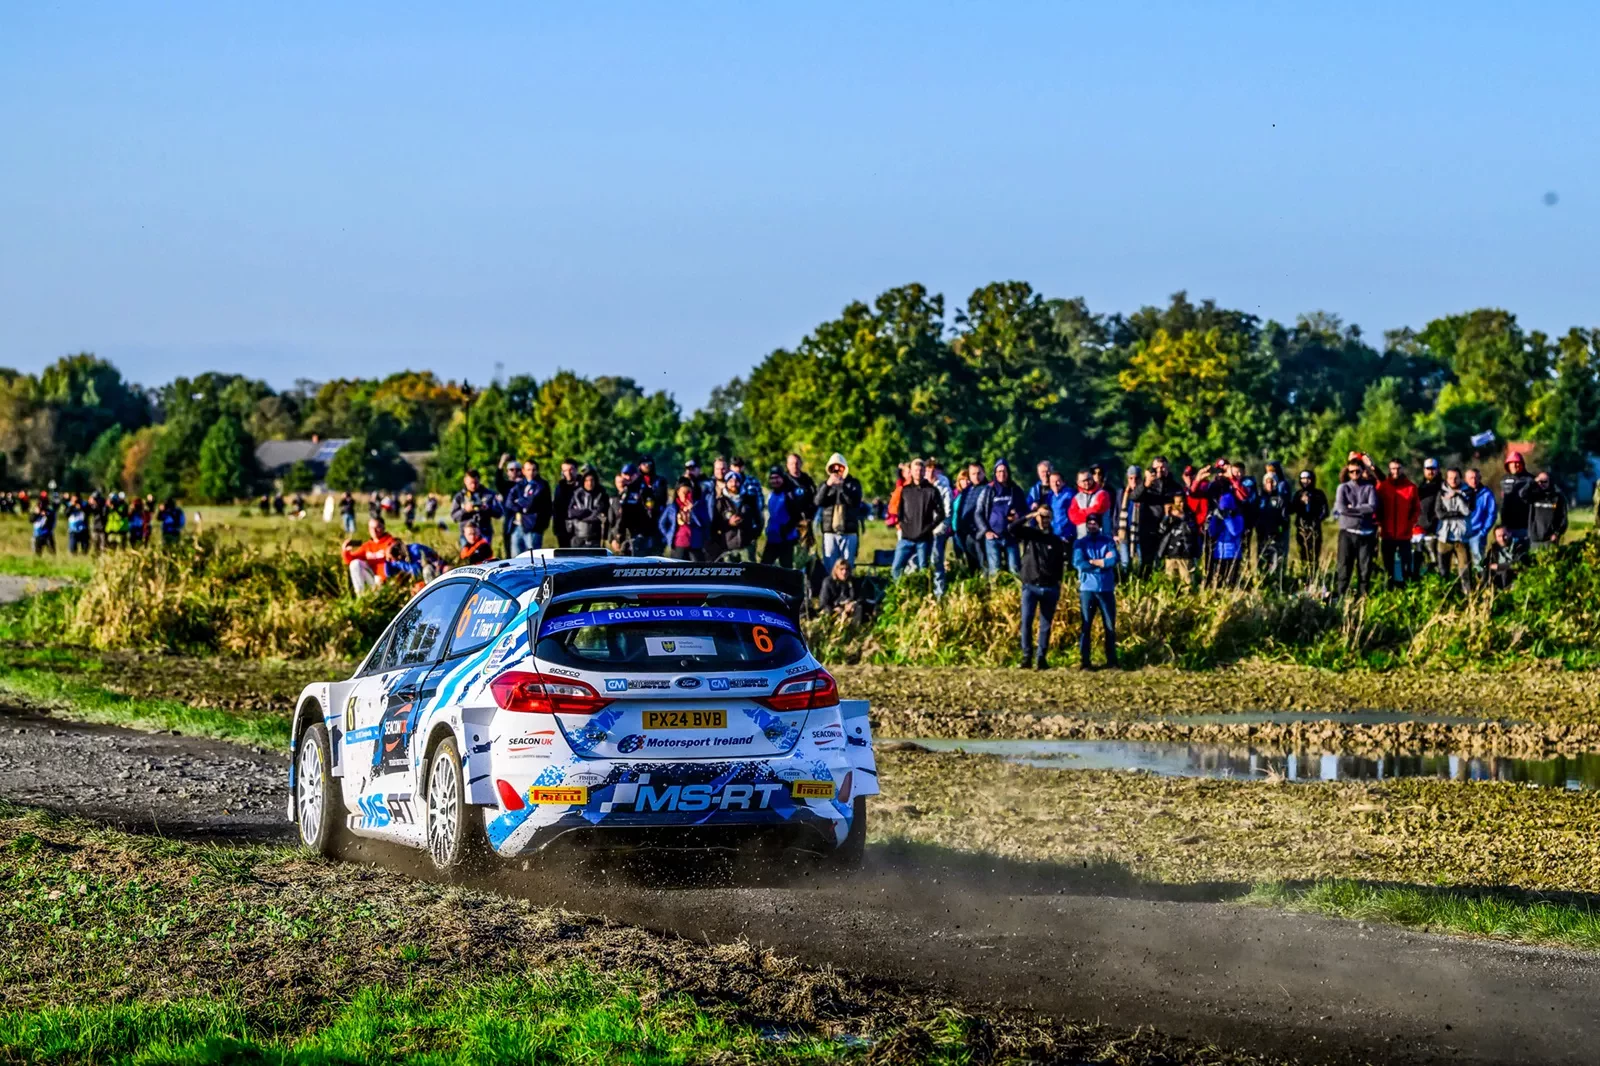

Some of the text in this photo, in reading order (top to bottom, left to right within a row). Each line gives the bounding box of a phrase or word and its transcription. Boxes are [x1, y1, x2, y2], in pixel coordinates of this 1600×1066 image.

[613, 567, 742, 577] THRUSTMASTER
[456, 593, 479, 639] 6
[608, 609, 684, 620] FOLLOW US ON
[752, 625, 774, 654] 6
[549, 667, 581, 679] sparco
[680, 679, 698, 687] Ford
[650, 711, 722, 727] PX24 BVB
[812, 731, 836, 739] SEACON
[508, 737, 553, 746] SEACON UK
[646, 735, 754, 748] Motorsport Ireland
[533, 789, 582, 802] PIRELLI
[796, 783, 832, 796] PIRELLI
